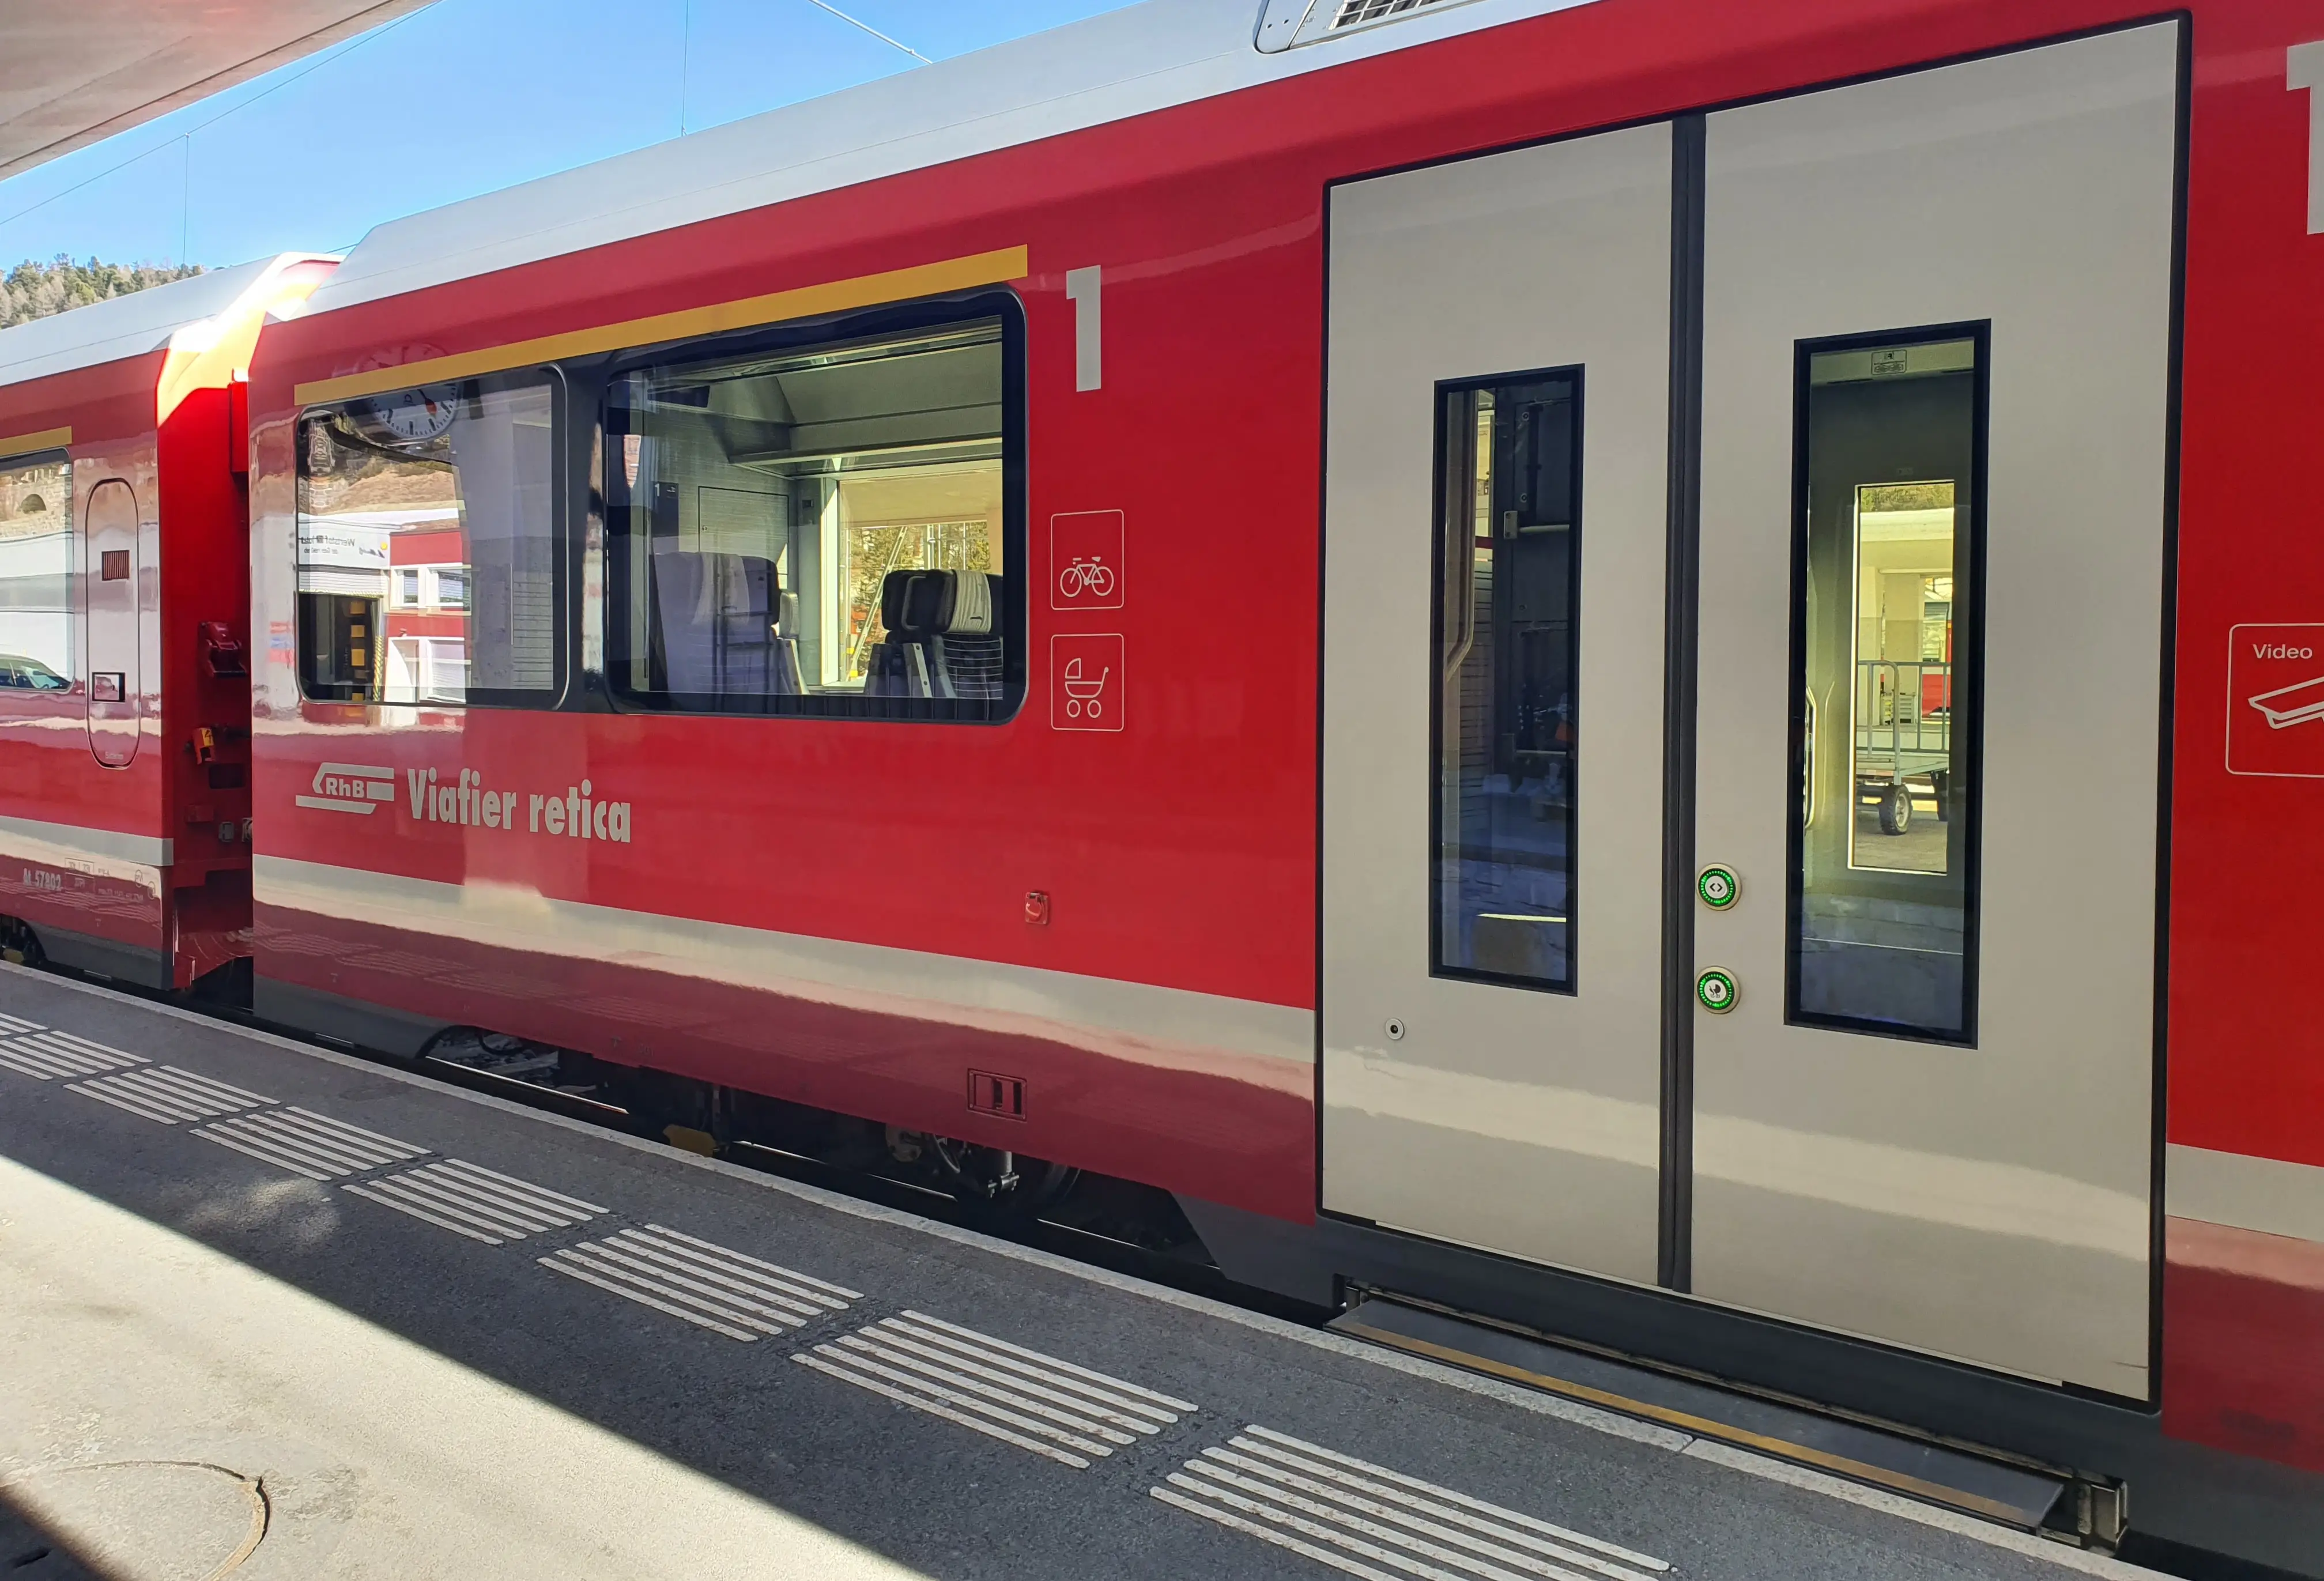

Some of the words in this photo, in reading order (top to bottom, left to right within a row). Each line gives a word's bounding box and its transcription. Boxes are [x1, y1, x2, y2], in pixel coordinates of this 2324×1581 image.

[1066, 265, 1101, 392] 1
[2253, 644, 2313, 659] Video
[326, 778, 365, 799] RhB
[407, 767, 516, 829] Viafier
[529, 779, 631, 843] retica
